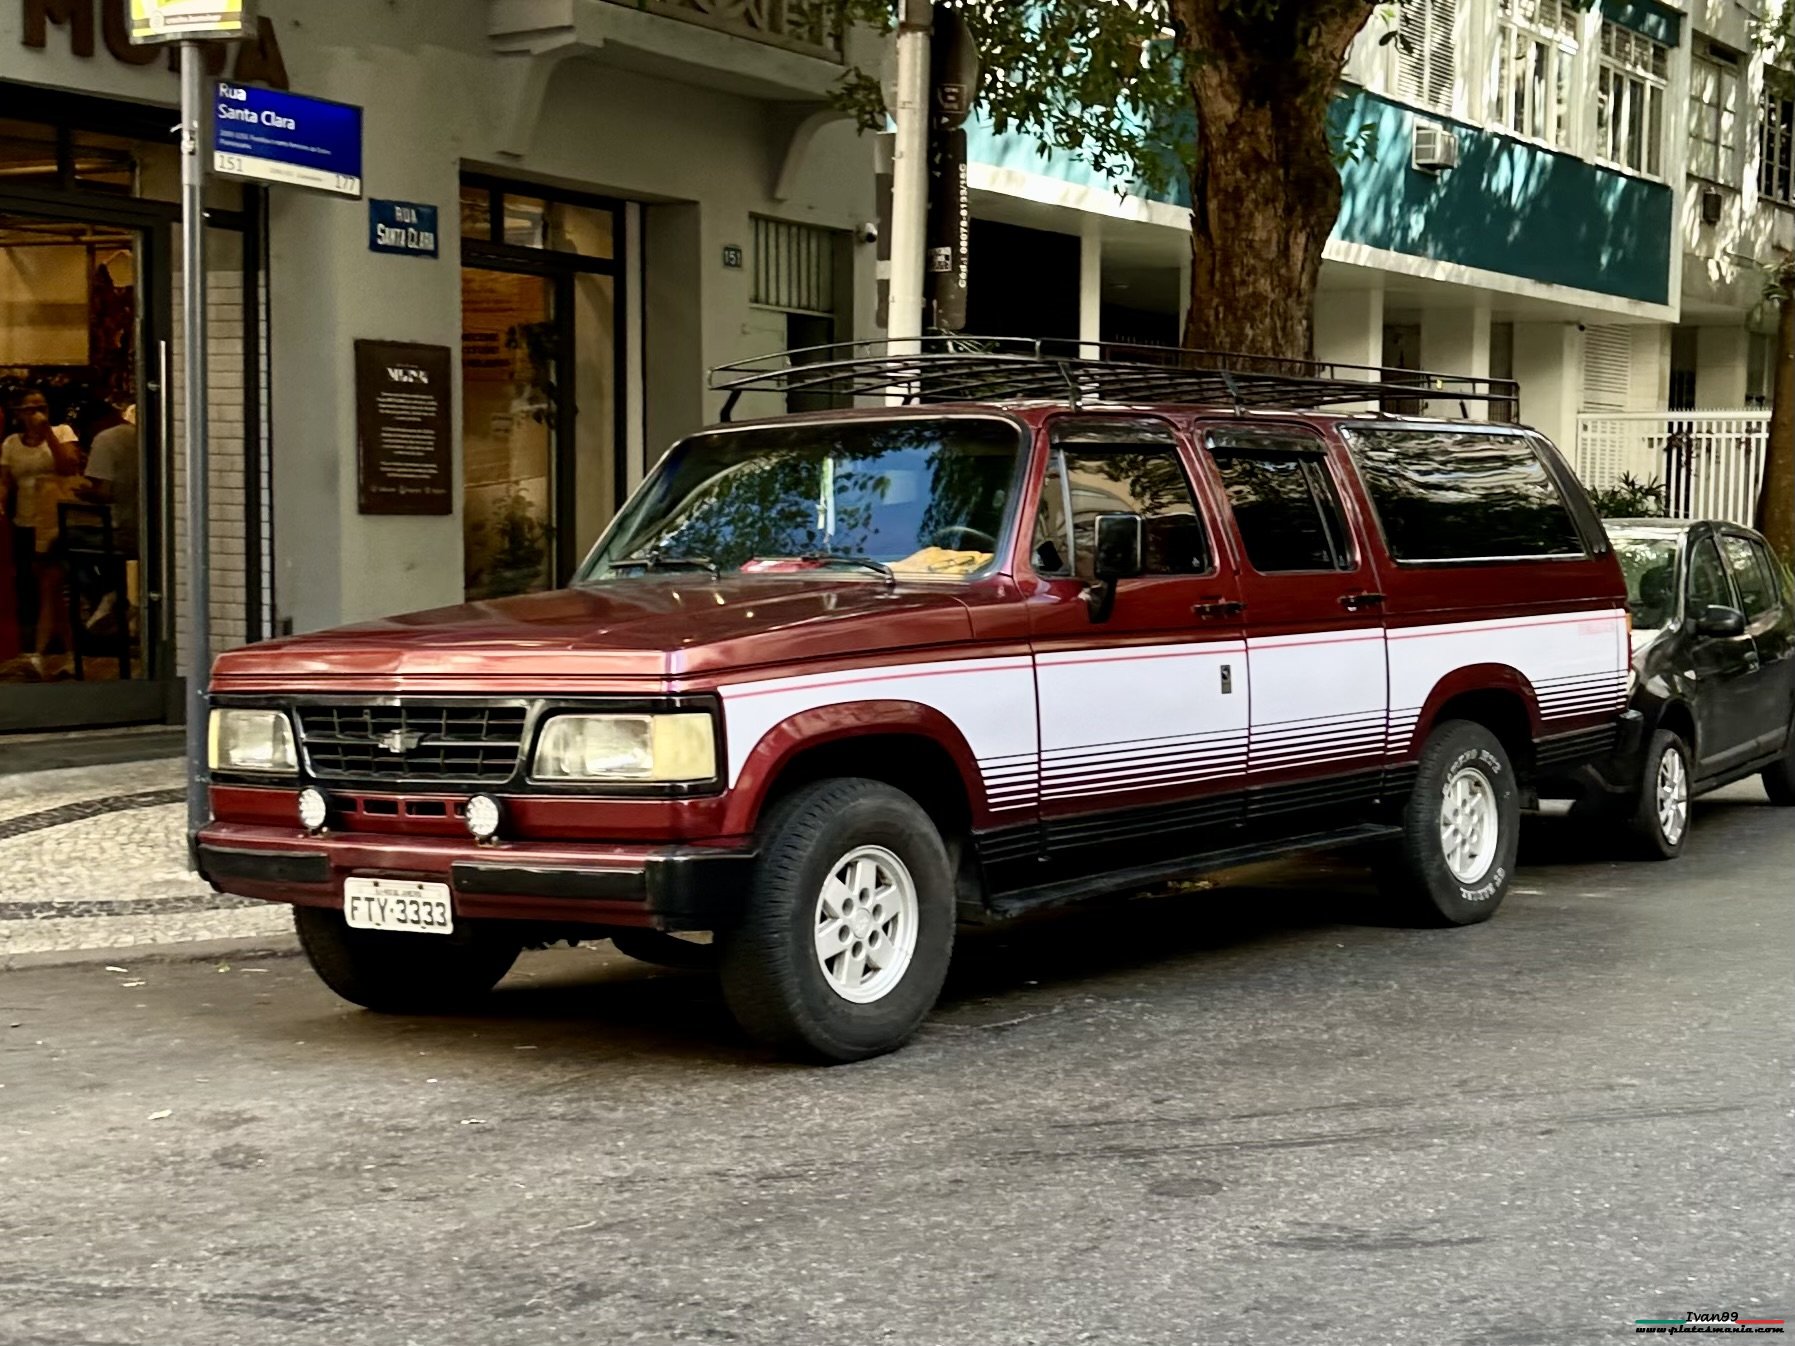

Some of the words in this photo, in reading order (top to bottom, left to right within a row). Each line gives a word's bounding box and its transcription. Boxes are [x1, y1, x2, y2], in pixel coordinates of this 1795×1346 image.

[219, 83, 246, 100] Rua
[218, 104, 258, 123] Santa
[261, 110, 295, 130] Clara
[219, 155, 243, 172] 151
[334, 172, 356, 190] 177
[394, 205, 418, 224] RUA
